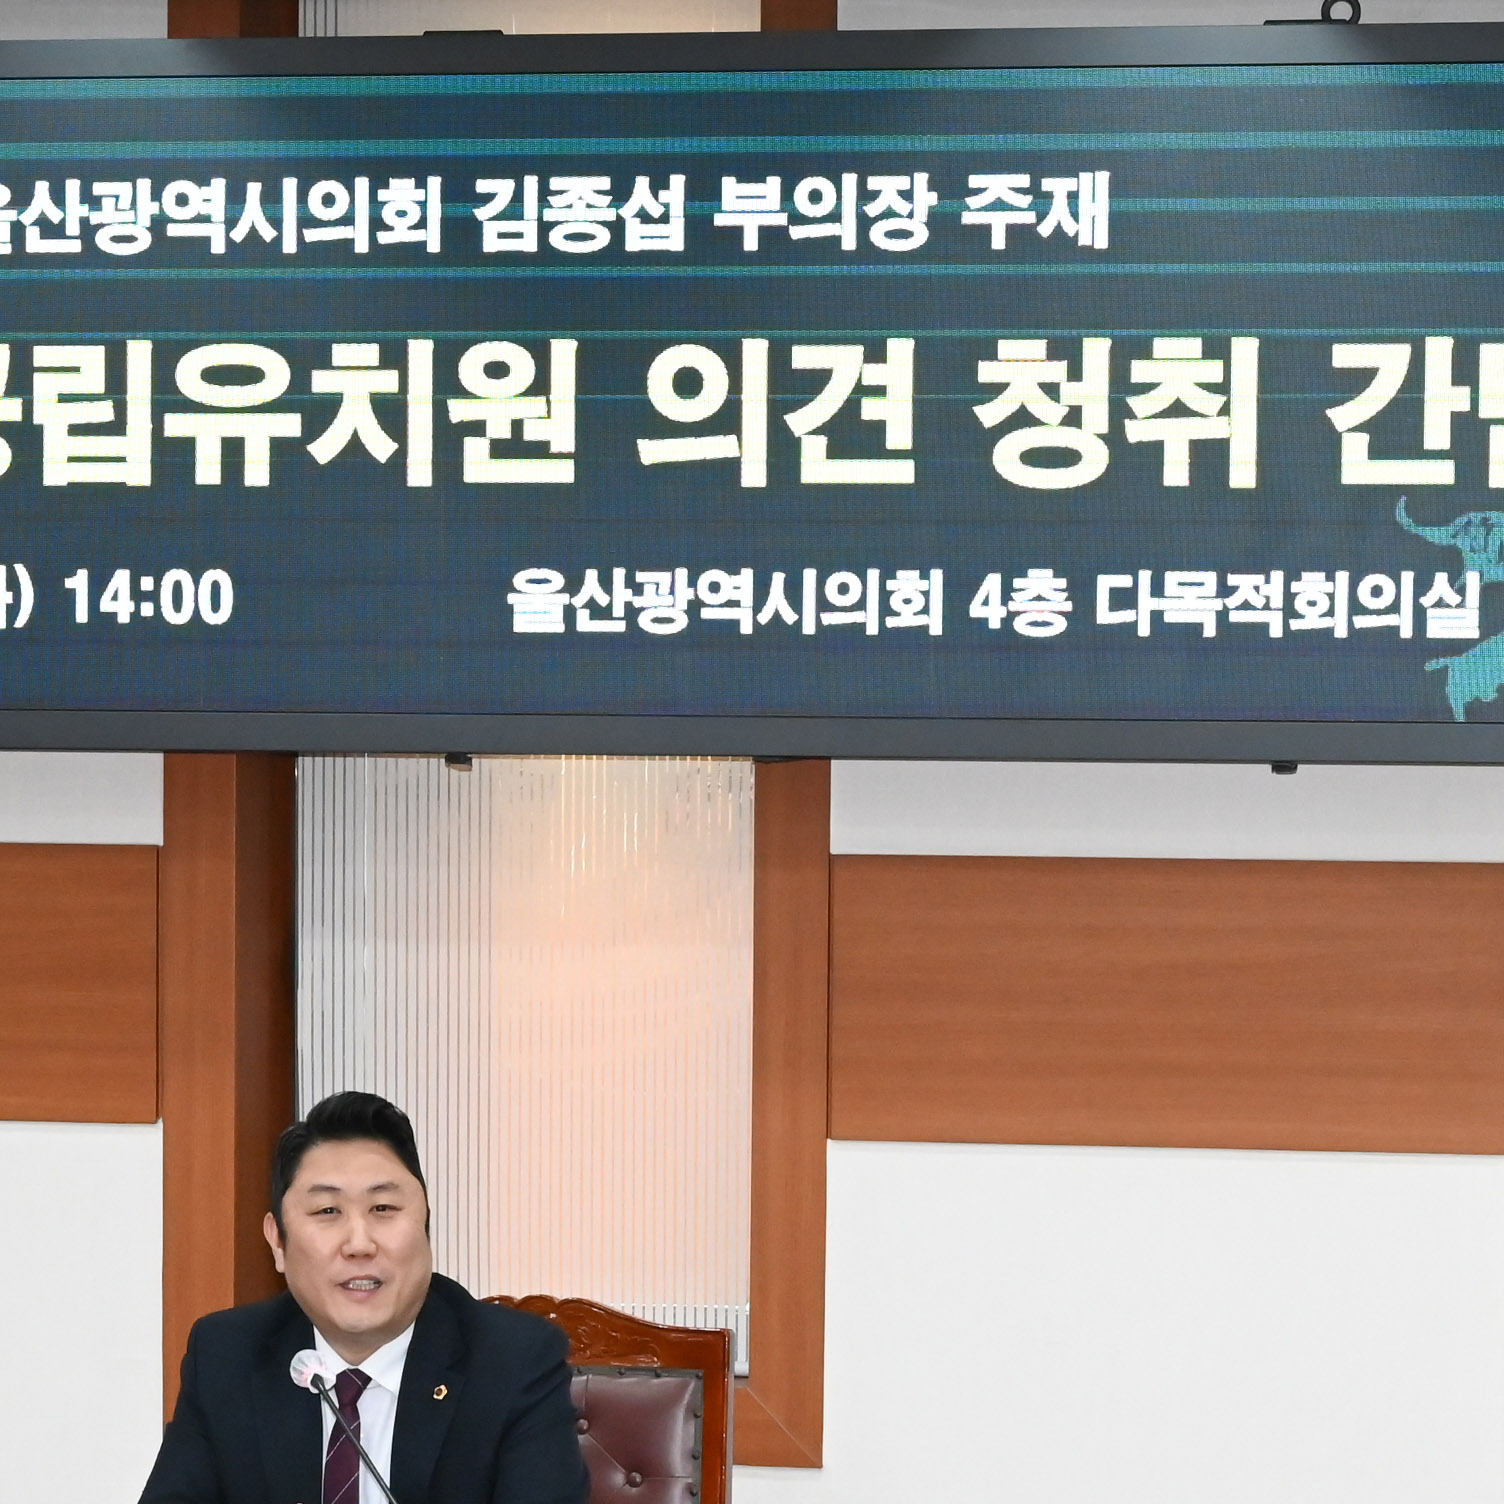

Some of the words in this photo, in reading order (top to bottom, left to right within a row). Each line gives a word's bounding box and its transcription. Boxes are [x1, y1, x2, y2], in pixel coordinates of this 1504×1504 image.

[473, 173, 686, 254] 김종섭
[713, 171, 938, 252] 부의장
[961, 169, 1110, 250] 주재
[635, 336, 915, 488] 의견
[973, 335, 1260, 490] 청취
[63, 567, 234, 626] 14:00
[505, 566, 944, 636] 울산광역시의회
[968, 567, 1073, 638] 4층
[1095, 568, 1481, 640] 다목적회의실
